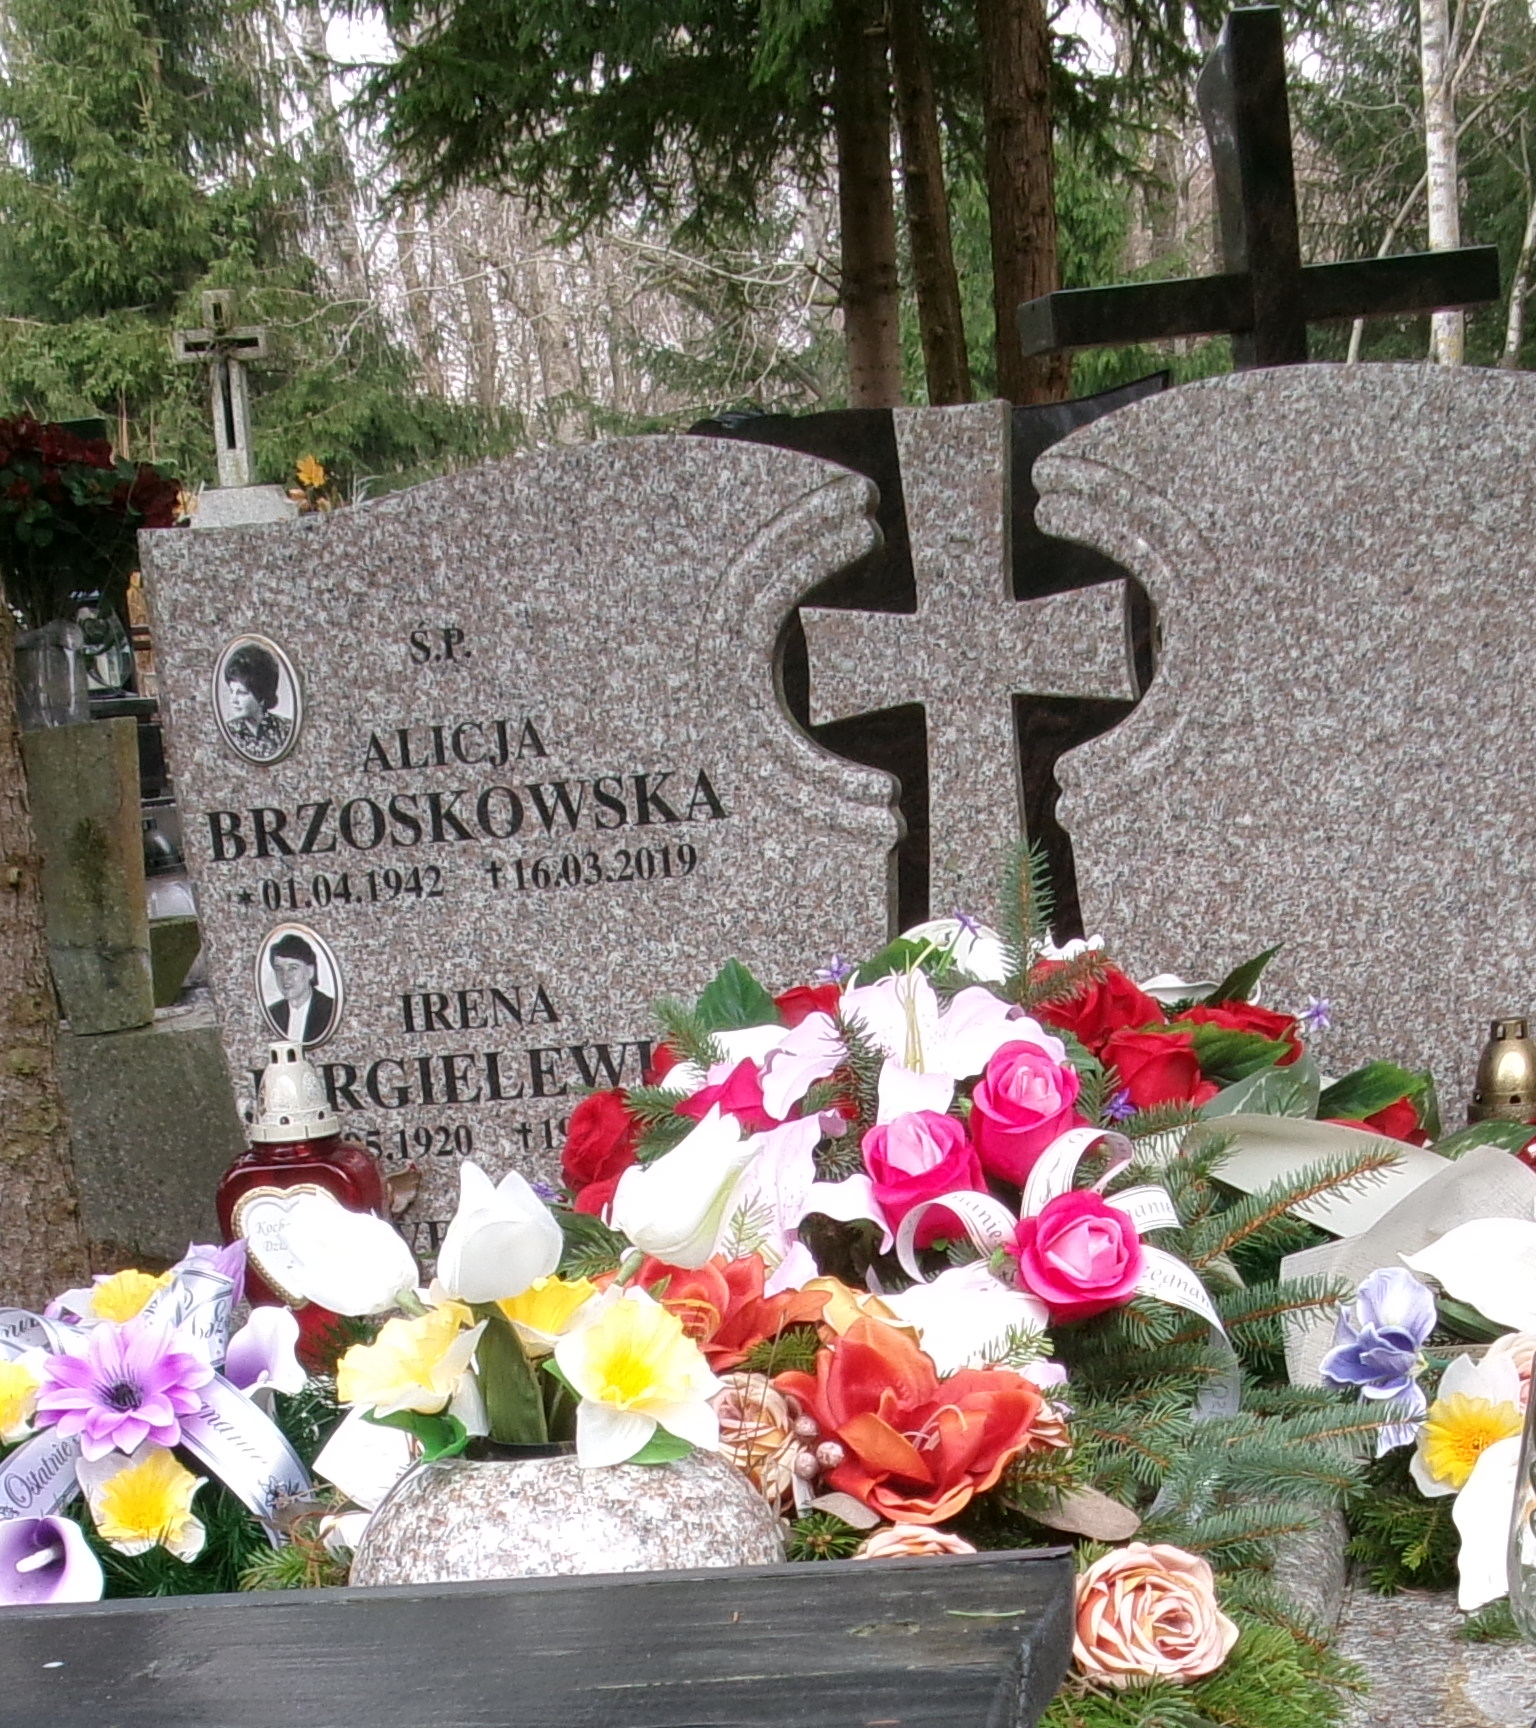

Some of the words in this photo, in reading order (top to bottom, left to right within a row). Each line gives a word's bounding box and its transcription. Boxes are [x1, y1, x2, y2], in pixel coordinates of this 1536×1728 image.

[361, 716, 549, 774] ALICJA
[206, 766, 732, 865] BRZOSKOWSKA
[401, 982, 561, 1035] IRENA
[4, 1438, 73, 1510] Ostatnie
